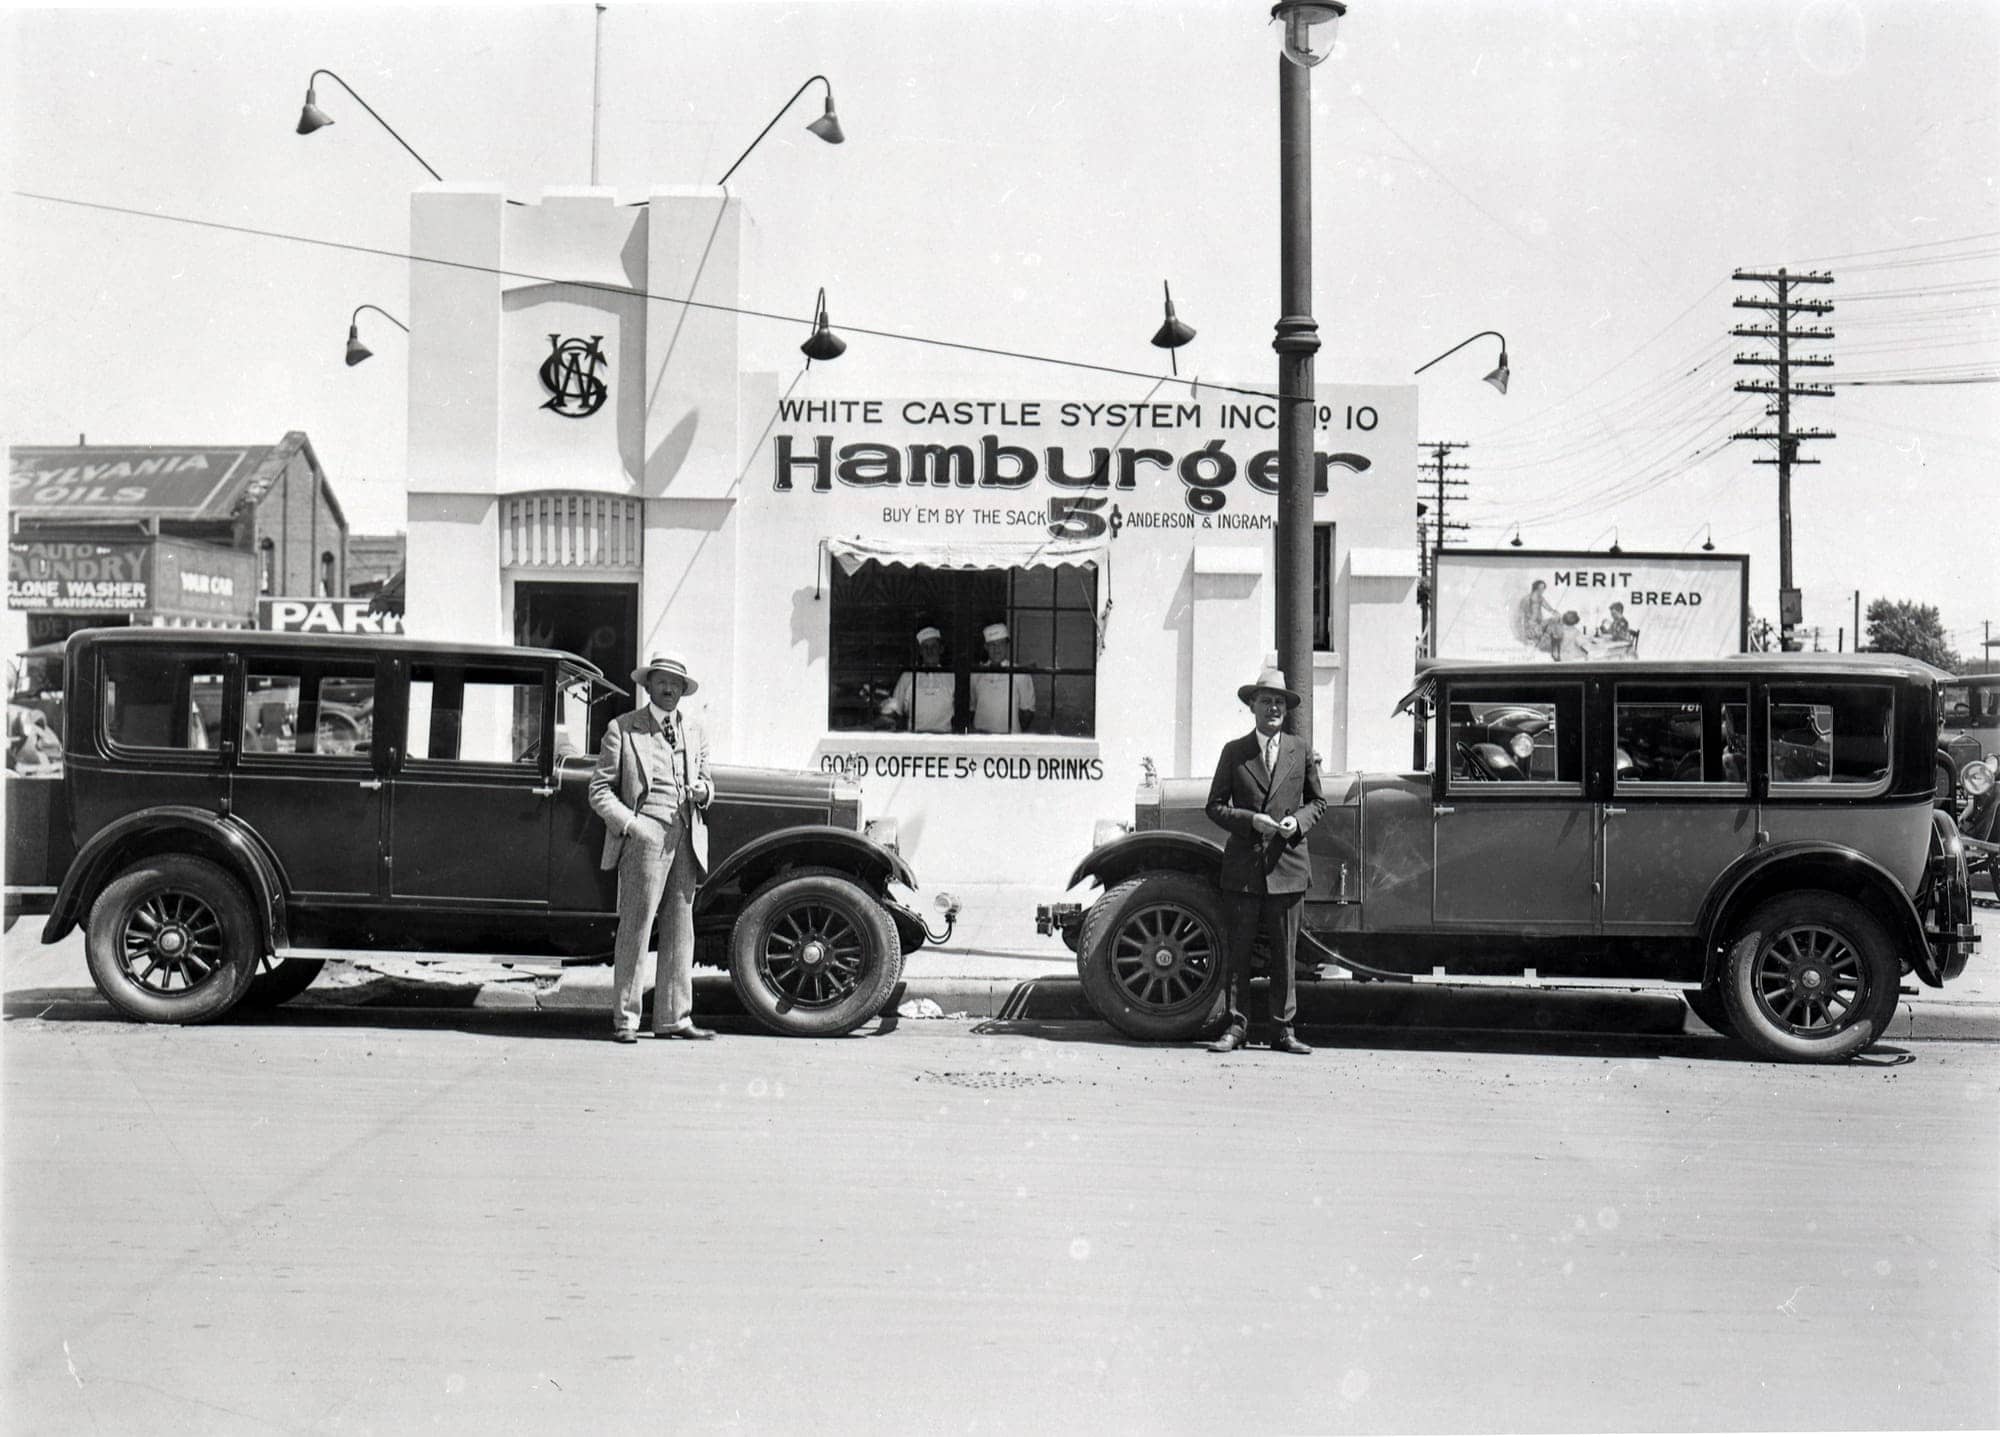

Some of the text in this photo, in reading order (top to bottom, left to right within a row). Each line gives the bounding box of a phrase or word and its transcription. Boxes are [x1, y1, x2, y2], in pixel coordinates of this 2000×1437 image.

[779, 400, 883, 423] WHITE
[902, 401, 1041, 426] CASTLE
[1060, 402, 1201, 429] SYSTEM
[1346, 406, 1379, 431] 10
[773, 434, 1372, 515] Hamburger
[34, 486, 149, 502] OILS
[883, 507, 912, 523] BUY
[945, 508, 965, 525] BY
[972, 508, 1001, 525] THE
[1005, 509, 1047, 526] SACK
[1047, 496, 1123, 541] 5¢
[1126, 511, 1273, 530] ANDERSON & INGRAM
[29, 543, 92, 559] AUTO
[1554, 571, 1632, 588] MERIT
[66, 582, 147, 598] WASHER
[1630, 591, 1702, 607] BREAD
[53, 597, 147, 609] SATISFACTORY
[875, 755, 950, 778] COFFEE
[954, 756, 977, 779] 5¢
[983, 756, 1031, 780] COLD
[1037, 758, 1104, 781] DRINKS
